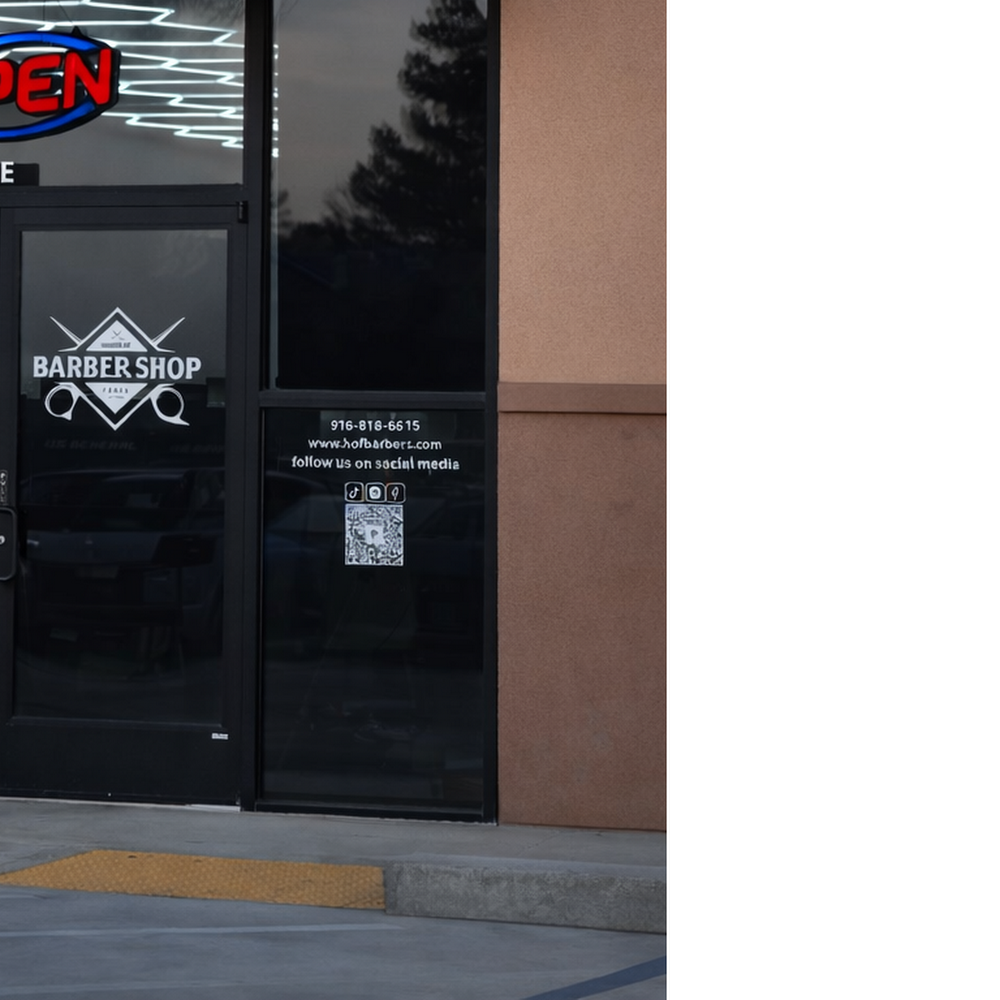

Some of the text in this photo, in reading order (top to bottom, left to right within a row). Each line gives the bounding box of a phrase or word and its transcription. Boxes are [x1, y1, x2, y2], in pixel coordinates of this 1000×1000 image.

[1, 161, 15, 184] E
[33, 355, 202, 380] BARBER SHOP
[330, 419, 421, 432] 916-818-6615
[291, 455, 333, 468] follow
[335, 457, 351, 468] us
[355, 459, 372, 469] on
